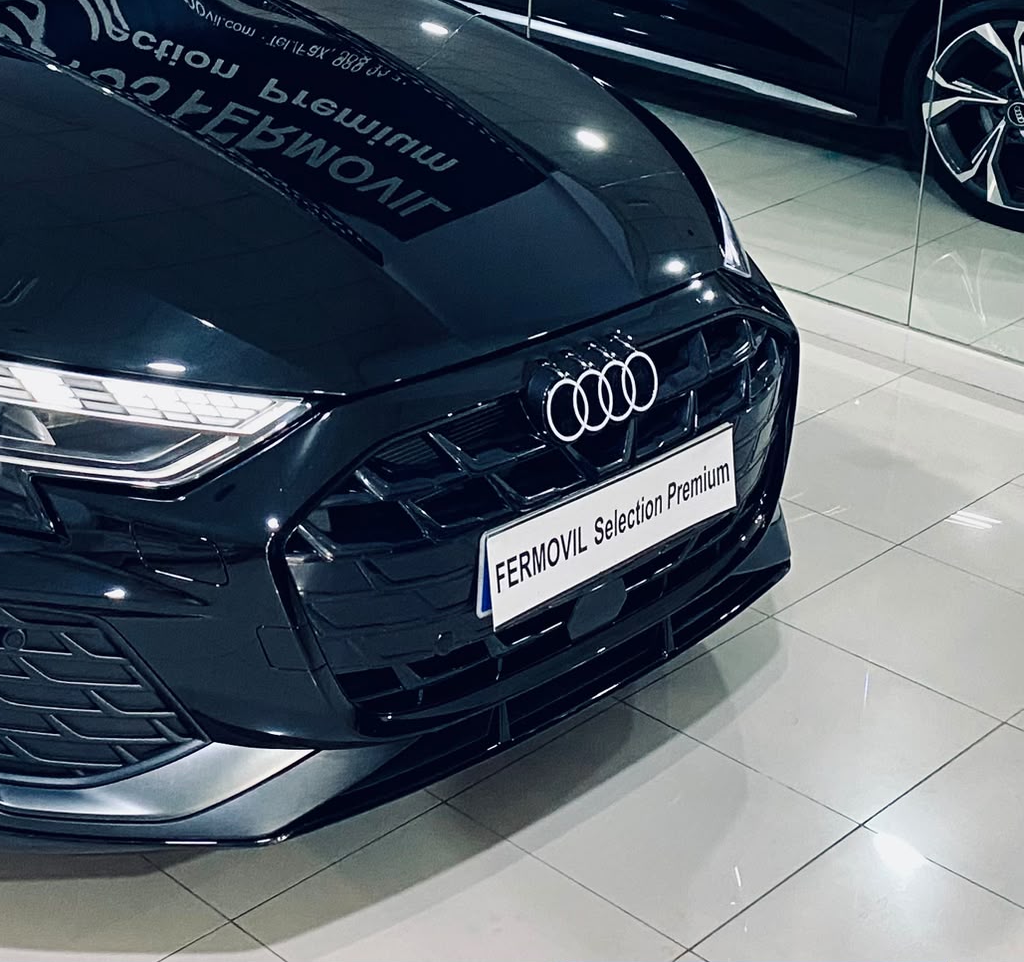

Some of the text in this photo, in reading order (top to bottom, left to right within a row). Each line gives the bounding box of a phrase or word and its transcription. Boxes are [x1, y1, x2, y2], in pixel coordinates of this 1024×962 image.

[495, 462, 730, 594] FERMOVIL Selection Premium
